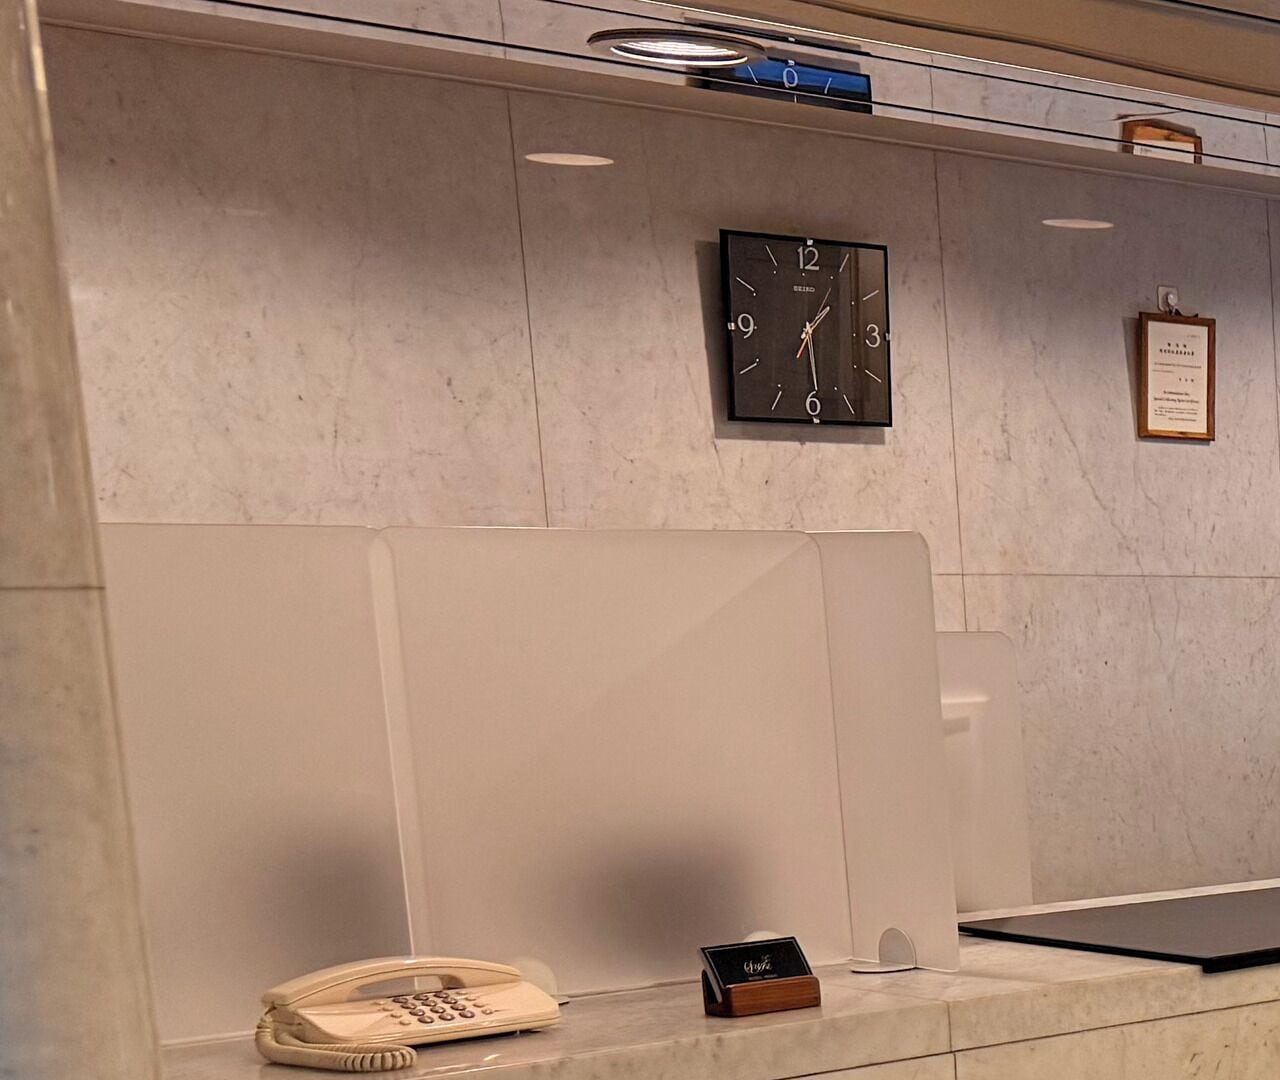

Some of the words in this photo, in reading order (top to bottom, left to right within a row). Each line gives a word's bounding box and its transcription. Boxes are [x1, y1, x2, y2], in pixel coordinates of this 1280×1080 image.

[797, 246, 820, 271] 12
[793, 285, 816, 293] SEIKO
[737, 313, 755, 339] 9
[865, 324, 881, 348] 3
[805, 391, 821, 416] 6
